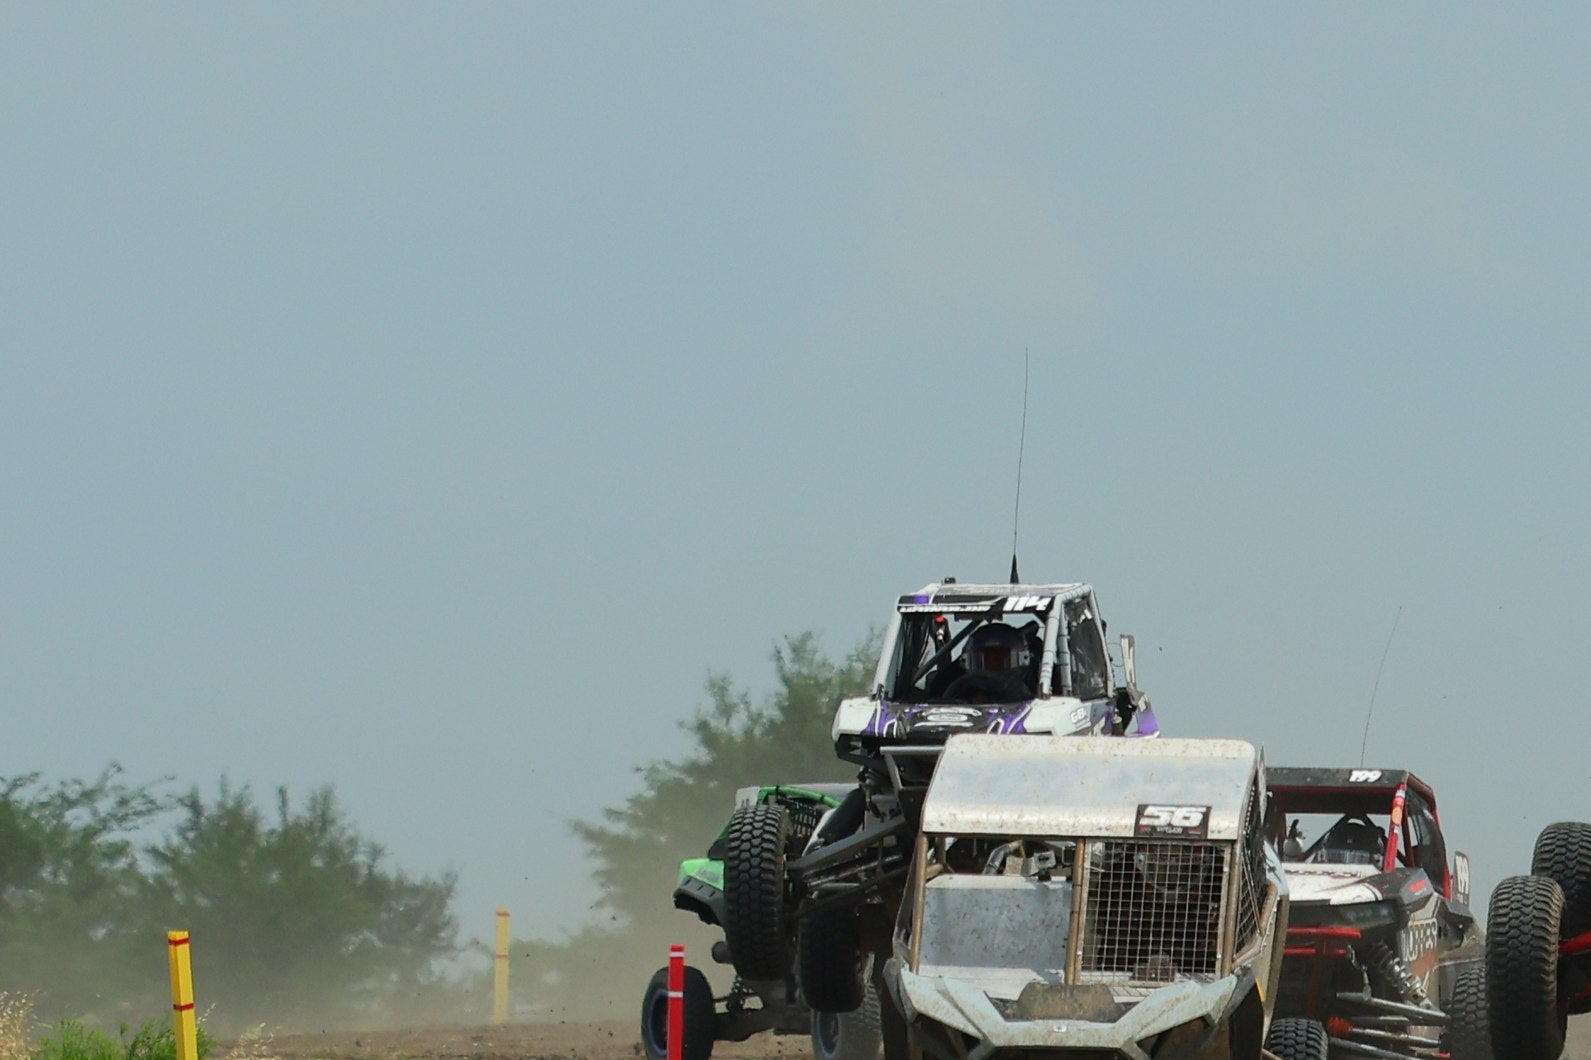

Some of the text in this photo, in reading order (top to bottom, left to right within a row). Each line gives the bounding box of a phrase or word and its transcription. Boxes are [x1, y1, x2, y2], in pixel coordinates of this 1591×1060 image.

[1002, 595, 1052, 612] 114
[1349, 769, 1383, 783] 199
[1138, 806, 1207, 828] 56
